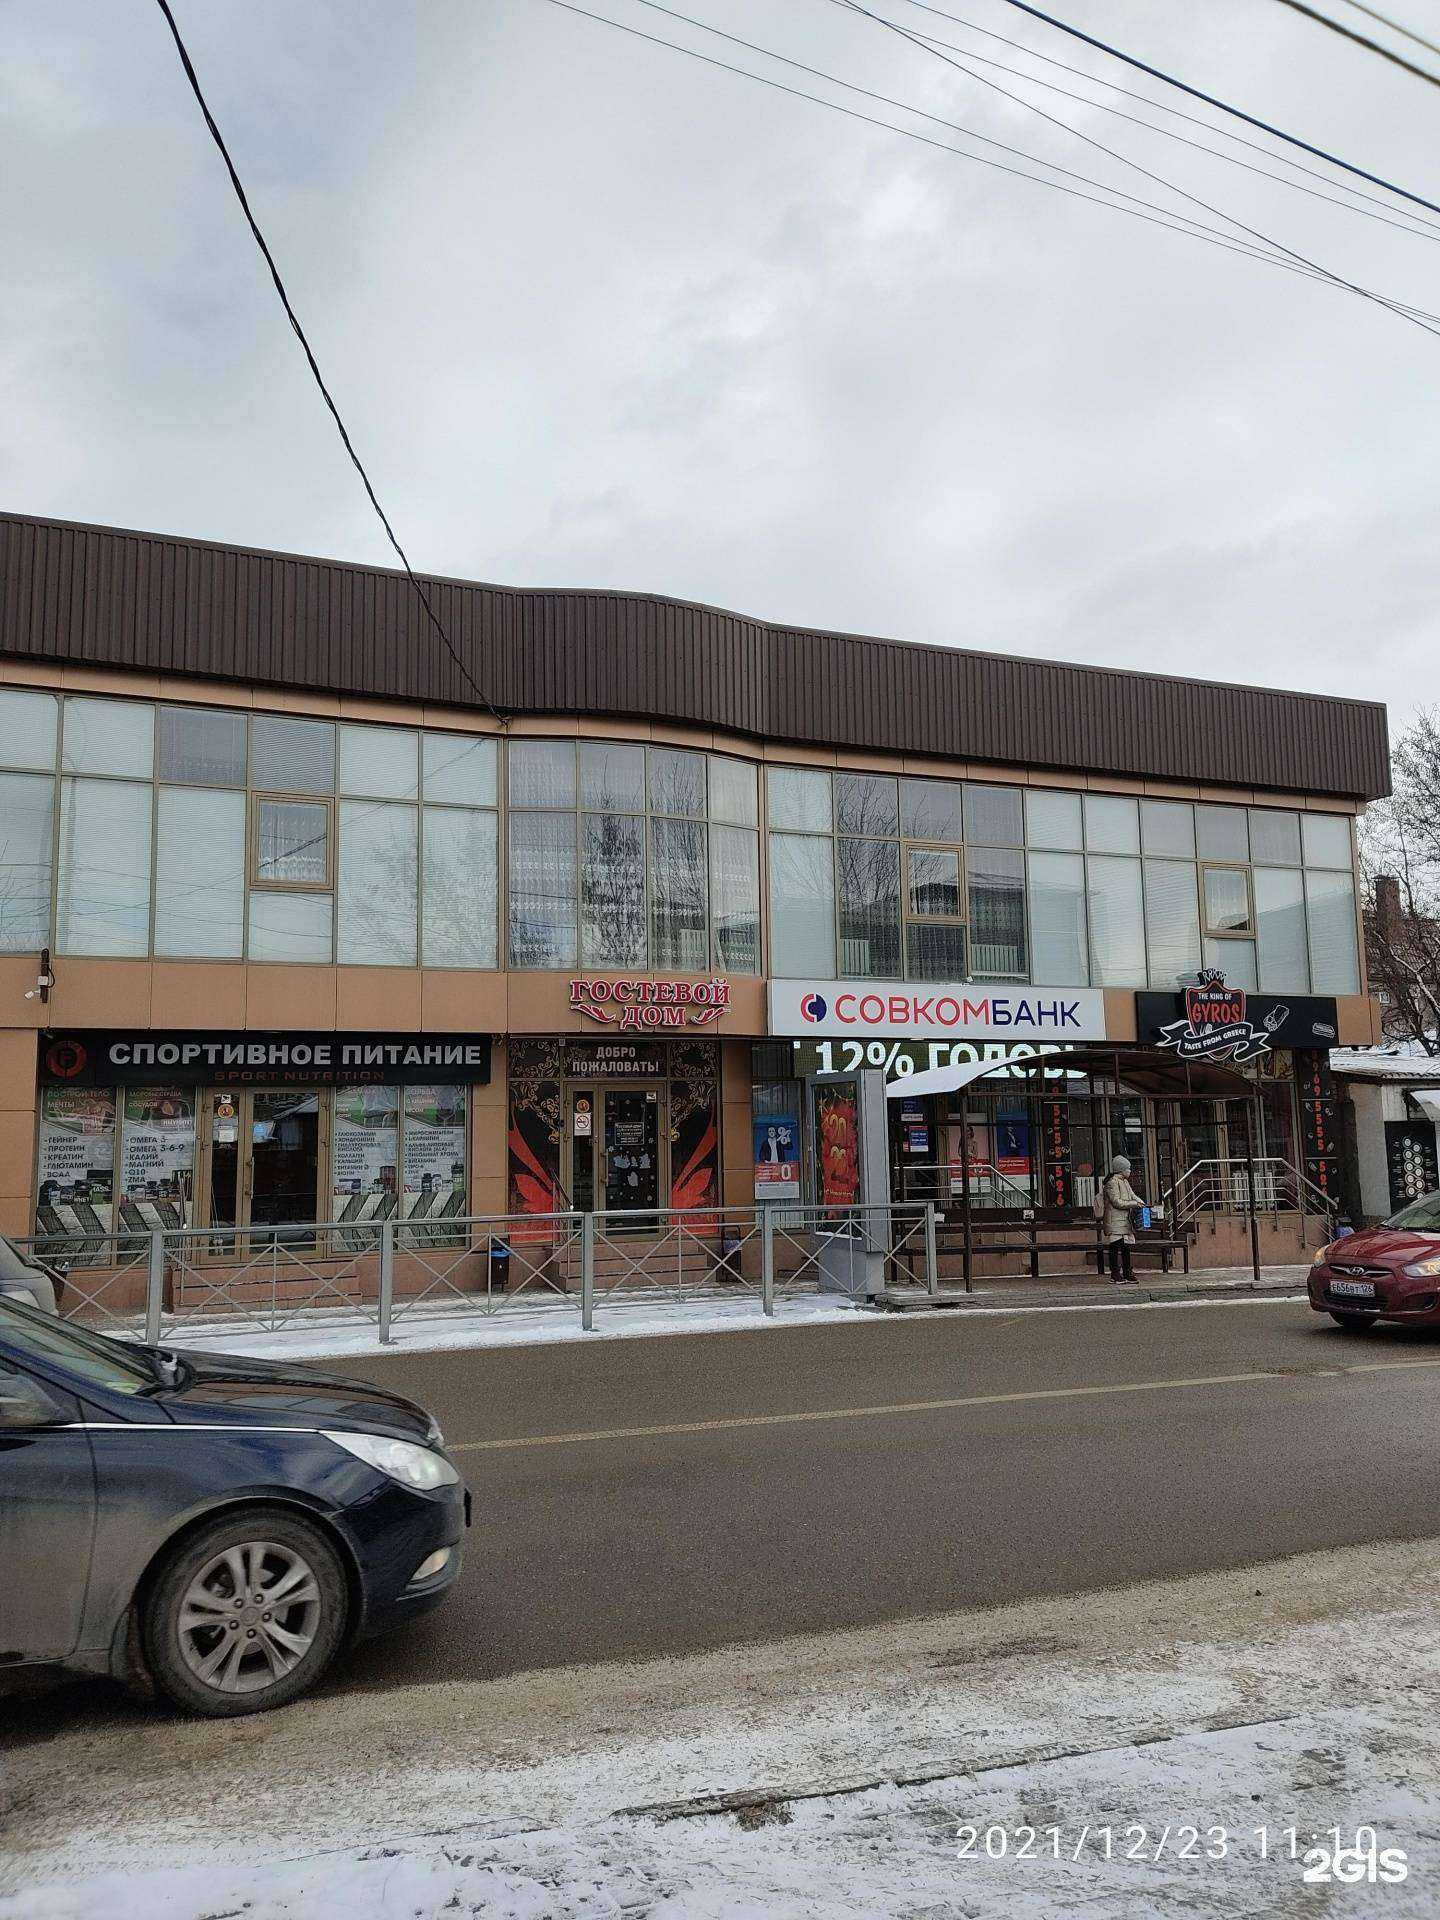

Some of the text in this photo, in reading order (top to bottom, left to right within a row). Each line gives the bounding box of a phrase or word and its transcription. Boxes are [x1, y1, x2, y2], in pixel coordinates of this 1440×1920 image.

[570, 977, 731, 1004] ГОСТЕВОЙ
[1198, 992, 1232, 1001] THE KING OF
[835, 994, 1081, 1027] СОВКОМБАНК
[1192, 1002, 1240, 1023] GYROS
[620, 1005, 686, 1030] ДОМ
[1184, 1028, 1247, 1050] TASTE FROM GREECE
[109, 1043, 481, 1065] СПОРТИВНОЕ ПИТАНИЕ
[596, 1046, 636, 1059] ДОБРО
[816, 1041, 914, 1078] 12%
[572, 1060, 659, 1072] ПОЖАЛОВАТЬ!
[214, 1071, 385, 1081] SPORT NUTRITION
[48, 1135, 78, 1144] ГЕЙНЕР
[129, 1136, 158, 1144] ОМЕГА
[48, 1144, 85, 1152] ПРОТЕИН
[129, 1145, 157, 1153] ОМЕГА
[129, 1152, 159, 1161] КАЛИЙ
[128, 1160, 165, 1168] МАГНИЙ
[781, 1164, 792, 1180] 0
